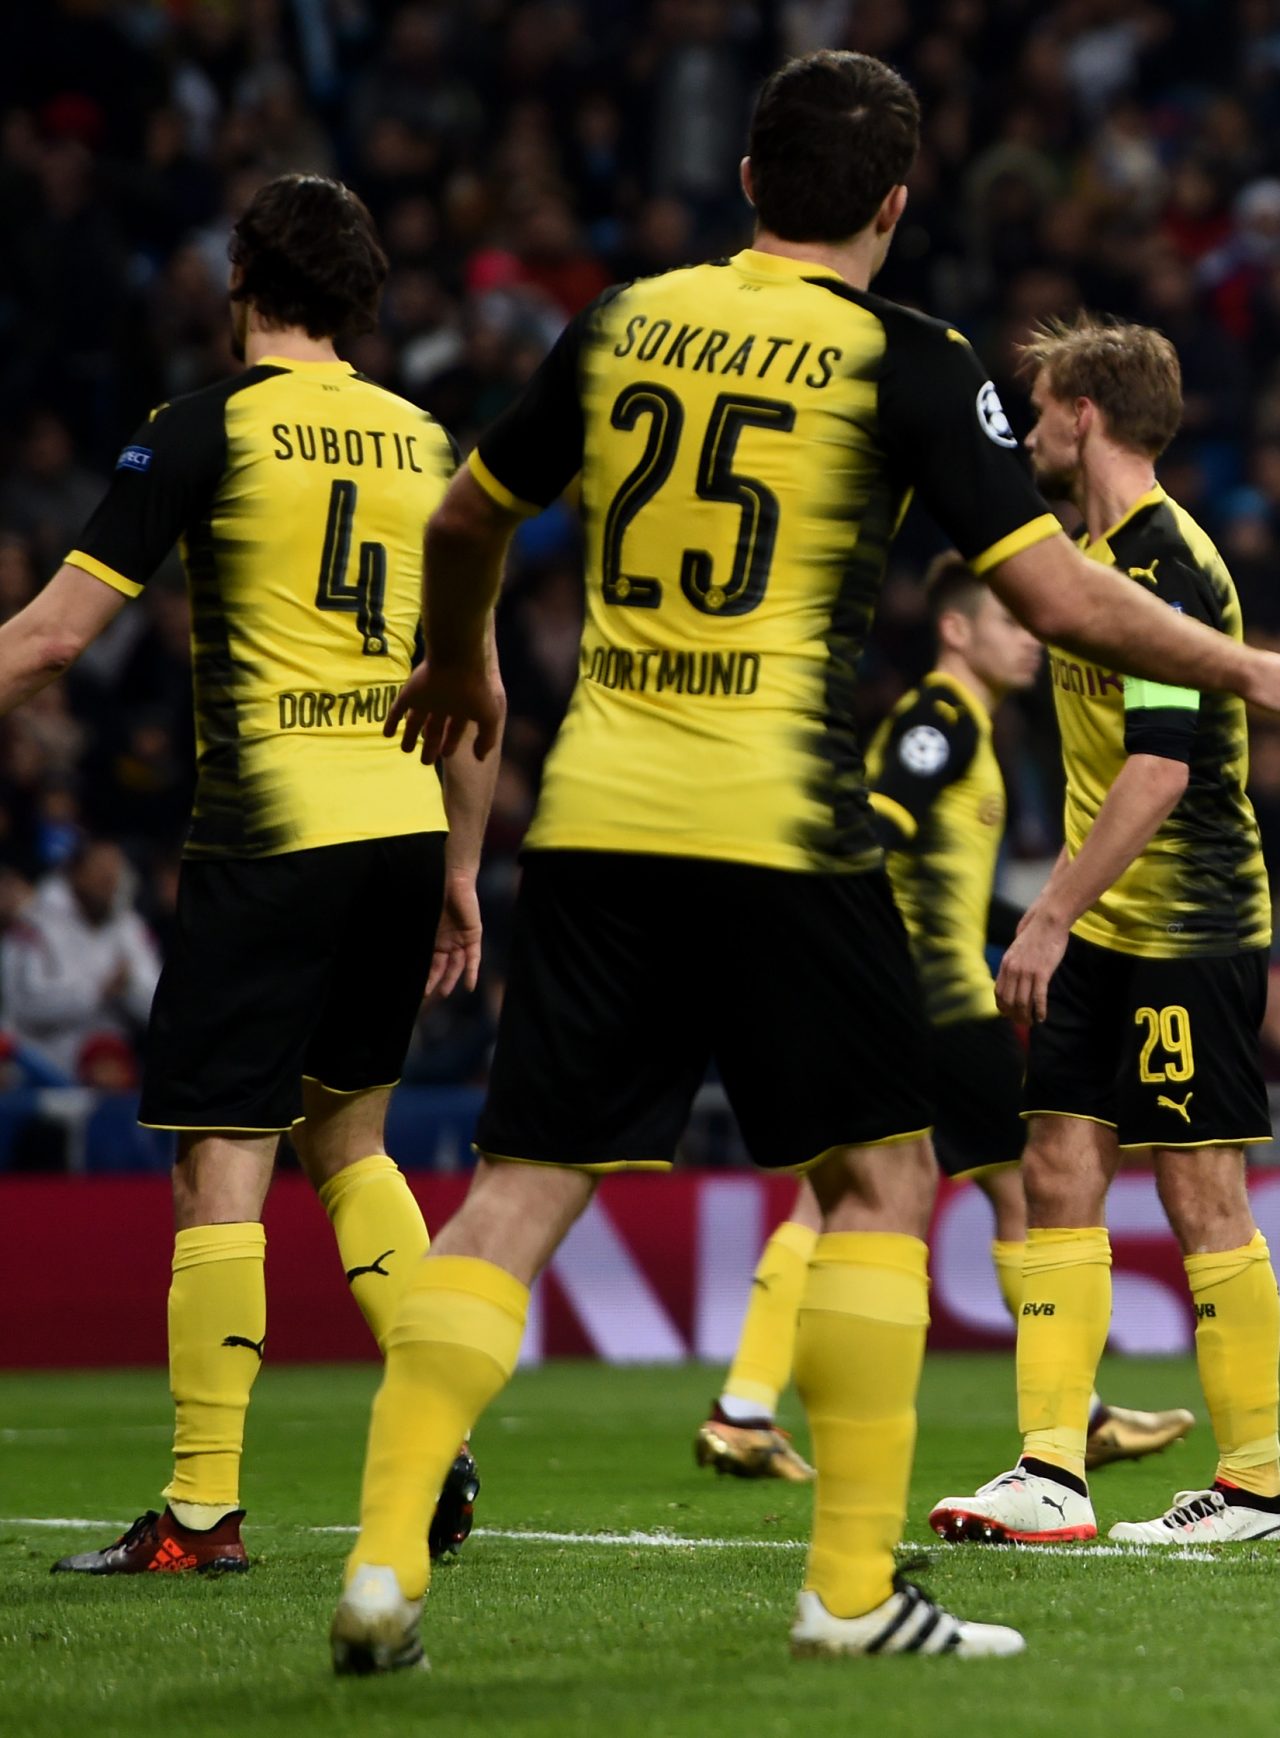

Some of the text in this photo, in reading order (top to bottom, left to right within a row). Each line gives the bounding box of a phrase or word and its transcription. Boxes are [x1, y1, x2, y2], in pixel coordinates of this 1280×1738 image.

[614, 314, 843, 389] SOKRATIS
[272, 423, 423, 474] SUBOTIC
[602, 381, 797, 617] 25
[315, 479, 389, 656] 4
[279, 684, 407, 730] DORTMU
[1135, 1005, 1195, 1082] 29
[1022, 1302, 1056, 1317] BVB
[1195, 1302, 1216, 1320] VB
